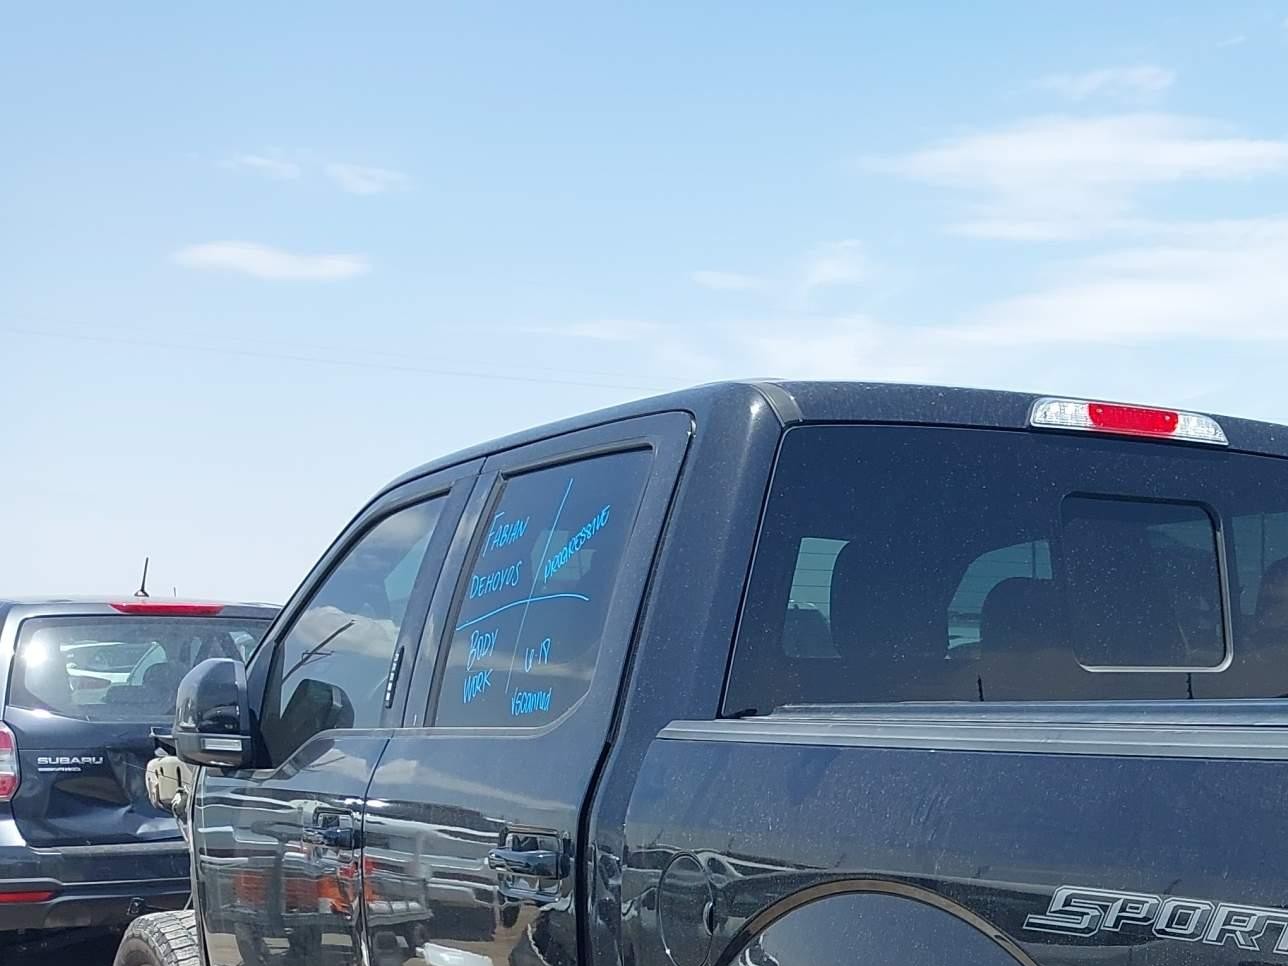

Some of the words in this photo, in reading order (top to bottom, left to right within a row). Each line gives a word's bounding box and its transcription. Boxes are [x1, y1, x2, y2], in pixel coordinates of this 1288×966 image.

[482, 511, 530, 558] FABIAN
[467, 628, 499, 672] BODY
[463, 668, 494, 704] WORK
[37, 756, 103, 765] SUBARU
